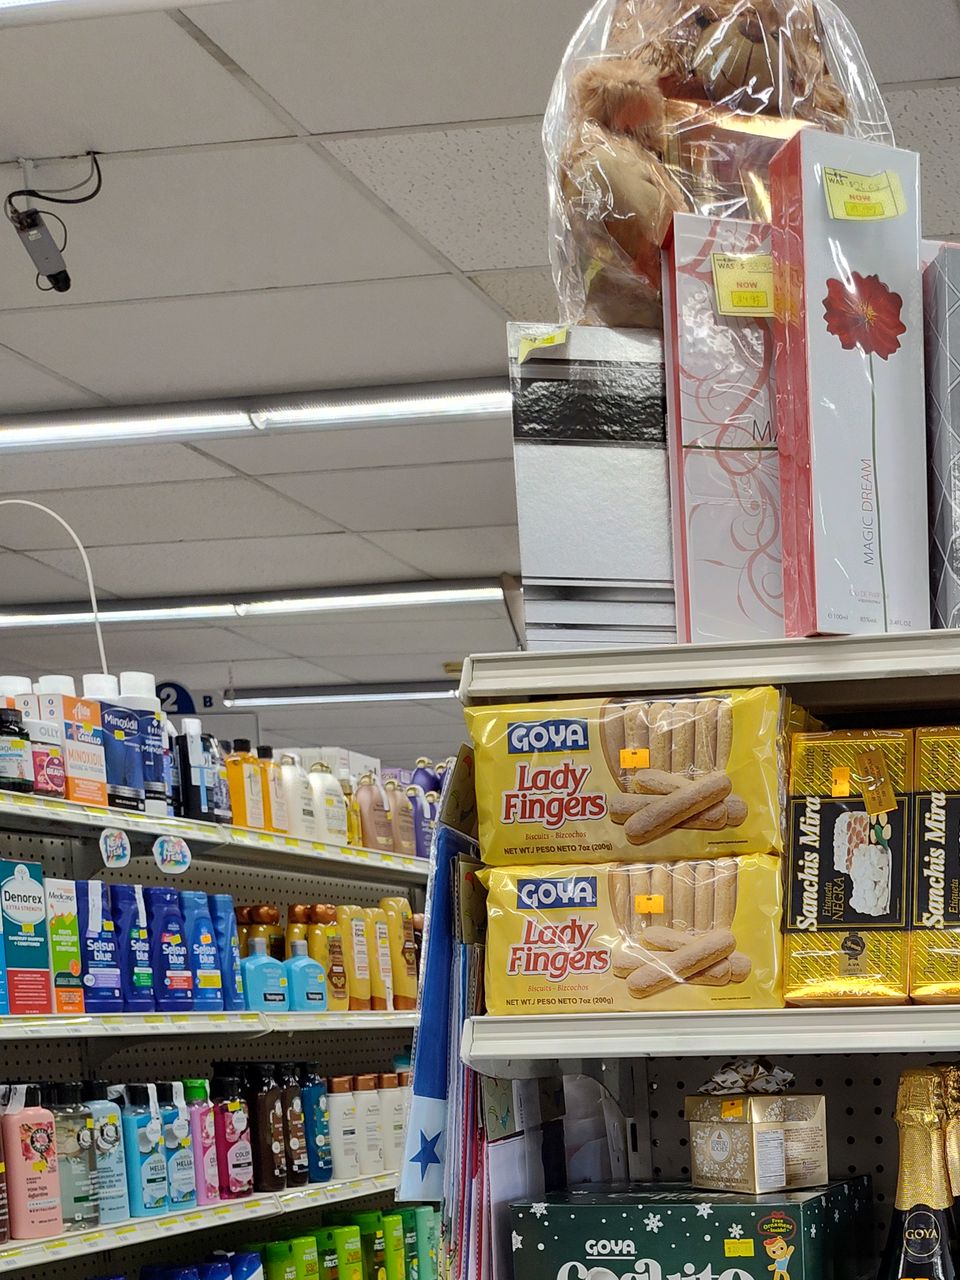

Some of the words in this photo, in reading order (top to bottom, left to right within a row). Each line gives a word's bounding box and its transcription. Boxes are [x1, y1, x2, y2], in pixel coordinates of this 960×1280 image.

[861, 459, 874, 513] DREAM
[862, 516, 874, 565] MAGIC
[160, 687, 177, 712] 2
[203, 696, 212, 707] B
[39, 727, 60, 738] OLLY
[105, 713, 138, 730] Minoxidil
[511, 723, 588, 752] GOYA
[69, 749, 104, 768] MINOXIDIL
[517, 762, 589, 797] Lady
[503, 792, 606, 826] Fingers
[924, 791, 947, 845] Mira
[799, 795, 822, 848] Mira
[526, 833, 549, 841] Biscuits
[504, 847, 518, 855] NET
[536, 846, 556, 854] PESO
[557, 845, 576, 853] NETO
[591, 843, 612, 852] (200g)
[4, 890, 43, 904] Denorex
[521, 881, 596, 907] GOYA
[796, 851, 821, 932] Sanchis
[823, 881, 833, 916] Etiqueta
[833, 876, 845, 921] NEGRA
[922, 848, 945, 929] Sanchis
[949, 879, 959, 914] Etiqueta
[87, 939, 115, 951] Selsun
[523, 917, 595, 952] Lady
[94, 951, 112, 961] blue
[162, 944, 187, 955] Selsun
[168, 954, 185, 964] blue
[193, 944, 216, 956] Selsun
[199, 954, 216, 964] blue
[508, 946, 609, 979] Fingers
[558, 997, 577, 1005] NETO
[592, 997, 614, 1005] (200g)
[905, 1228, 940, 1241] GOYA
[585, 1239, 637, 1255] GOYA
